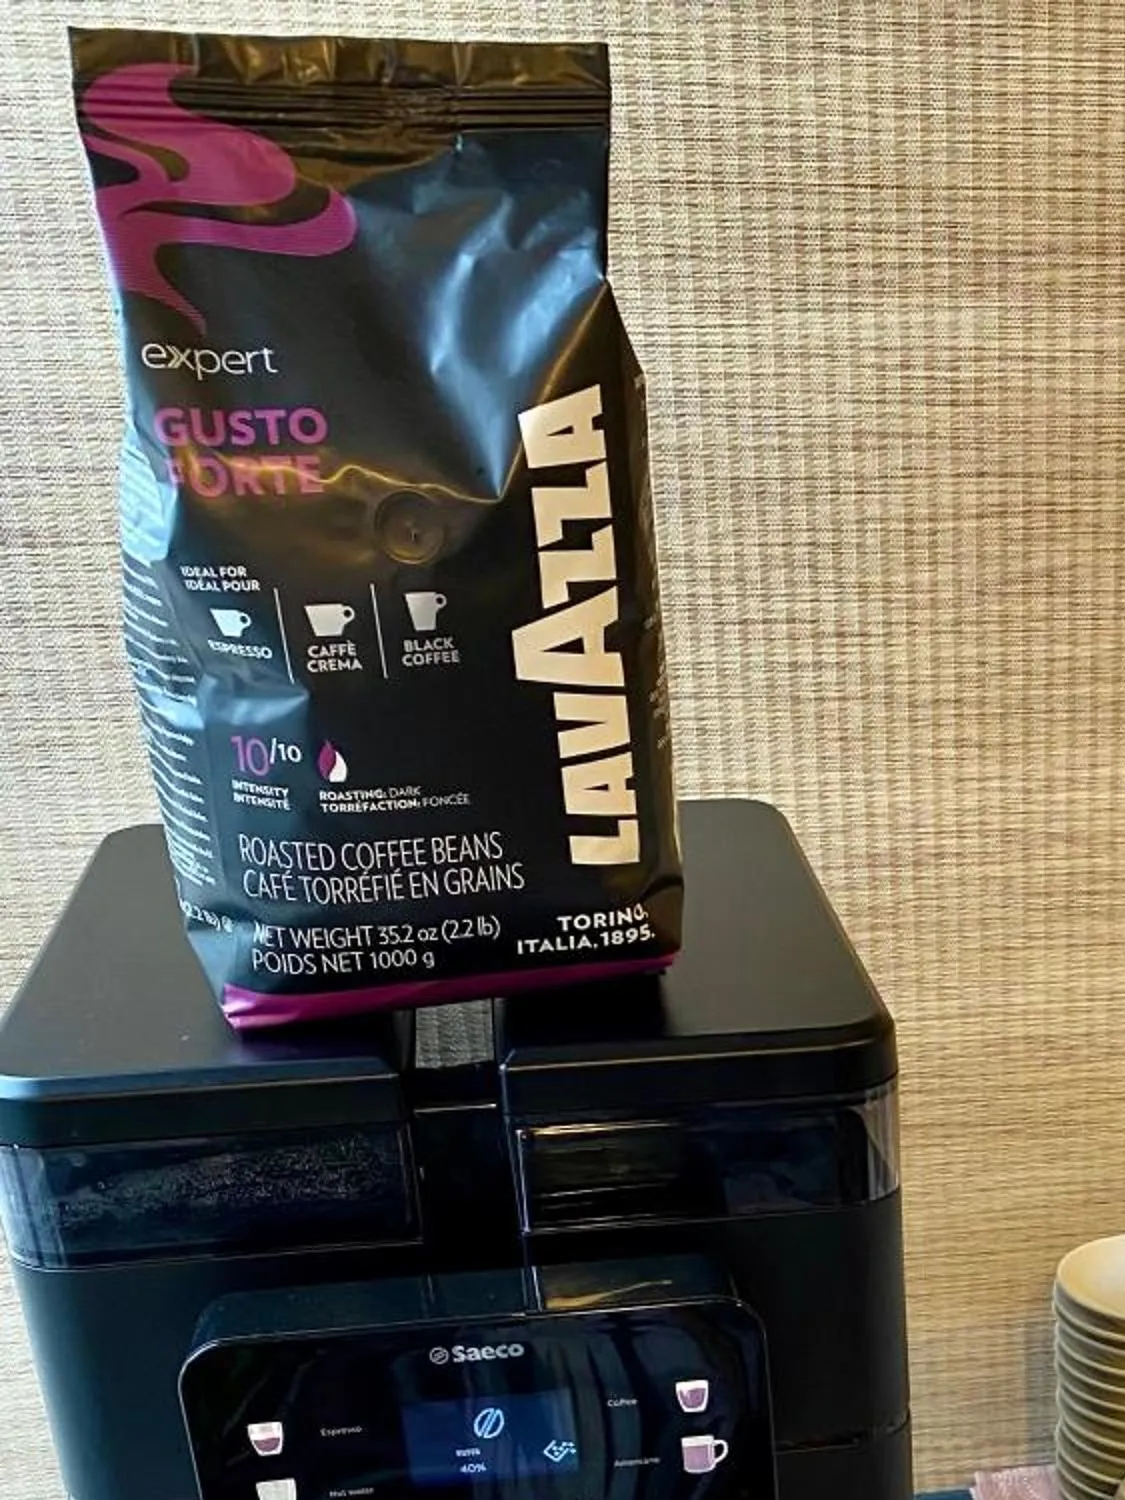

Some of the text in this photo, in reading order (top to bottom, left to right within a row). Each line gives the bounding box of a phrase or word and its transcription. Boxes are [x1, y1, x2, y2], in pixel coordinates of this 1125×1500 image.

[141, 343, 279, 381] expert
[154, 407, 329, 447] GUSTO
[219, 565, 248, 578] FOR
[221, 579, 261, 592] POUR
[511, 384, 640, 865] LAVAZZA
[403, 637, 455, 652] BLACK
[307, 658, 363, 673] CREMA
[401, 650, 460, 667] COFFEE
[231, 779, 289, 797] INTENSITY
[388, 785, 421, 799] DARK
[239, 831, 503, 873] ROASTED COFFEE BEANS
[243, 862, 525, 905] CAFÉ TORRÉFIÉ EN GRAINS
[253, 920, 287, 949] NET
[289, 925, 373, 949] WEIGHT
[417, 927, 440, 942] oz
[252, 948, 436, 976] POIDS NET 1000 g
[451, 1343, 526, 1363] Saeco
